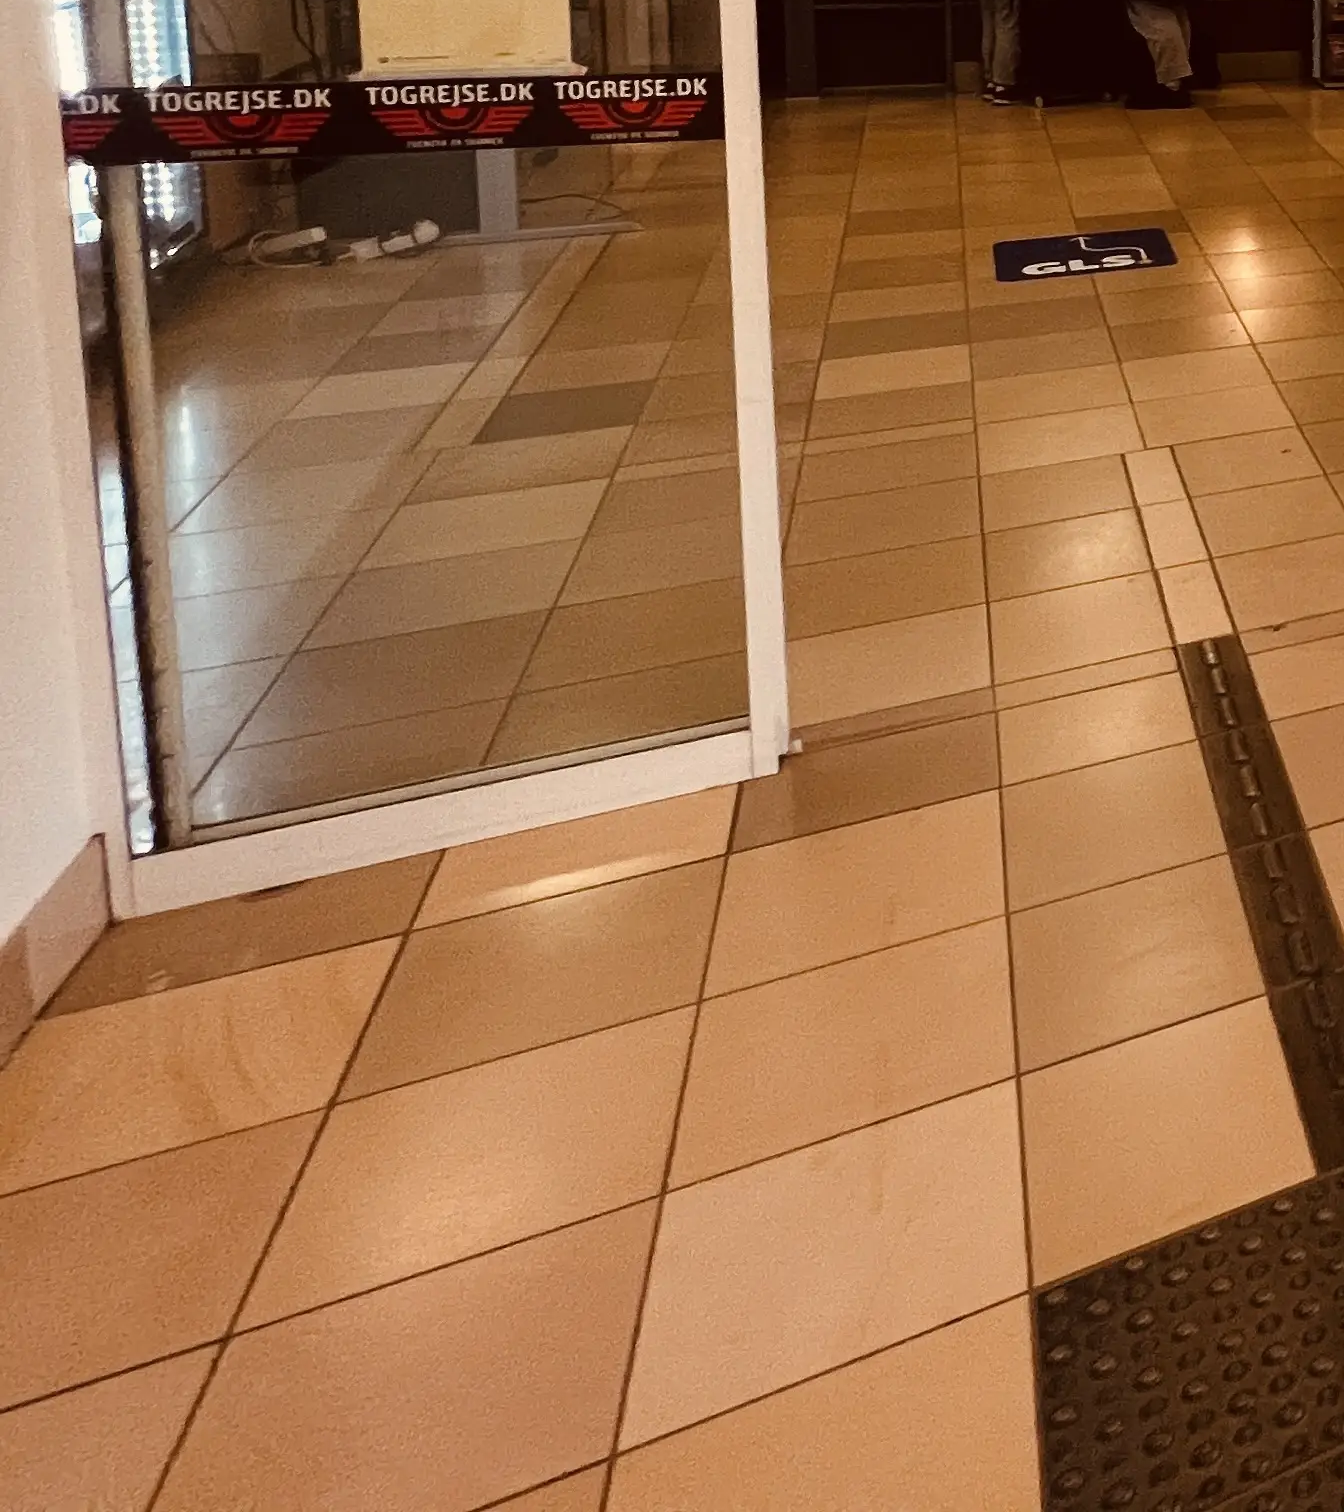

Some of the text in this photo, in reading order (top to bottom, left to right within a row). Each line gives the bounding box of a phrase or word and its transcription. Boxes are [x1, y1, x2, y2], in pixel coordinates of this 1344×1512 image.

[145, 88, 332, 114] TOGREJSE.DK
[365, 82, 534, 107] TOGREJSE.DK
[554, 78, 707, 102] TOGREJSE.DK
